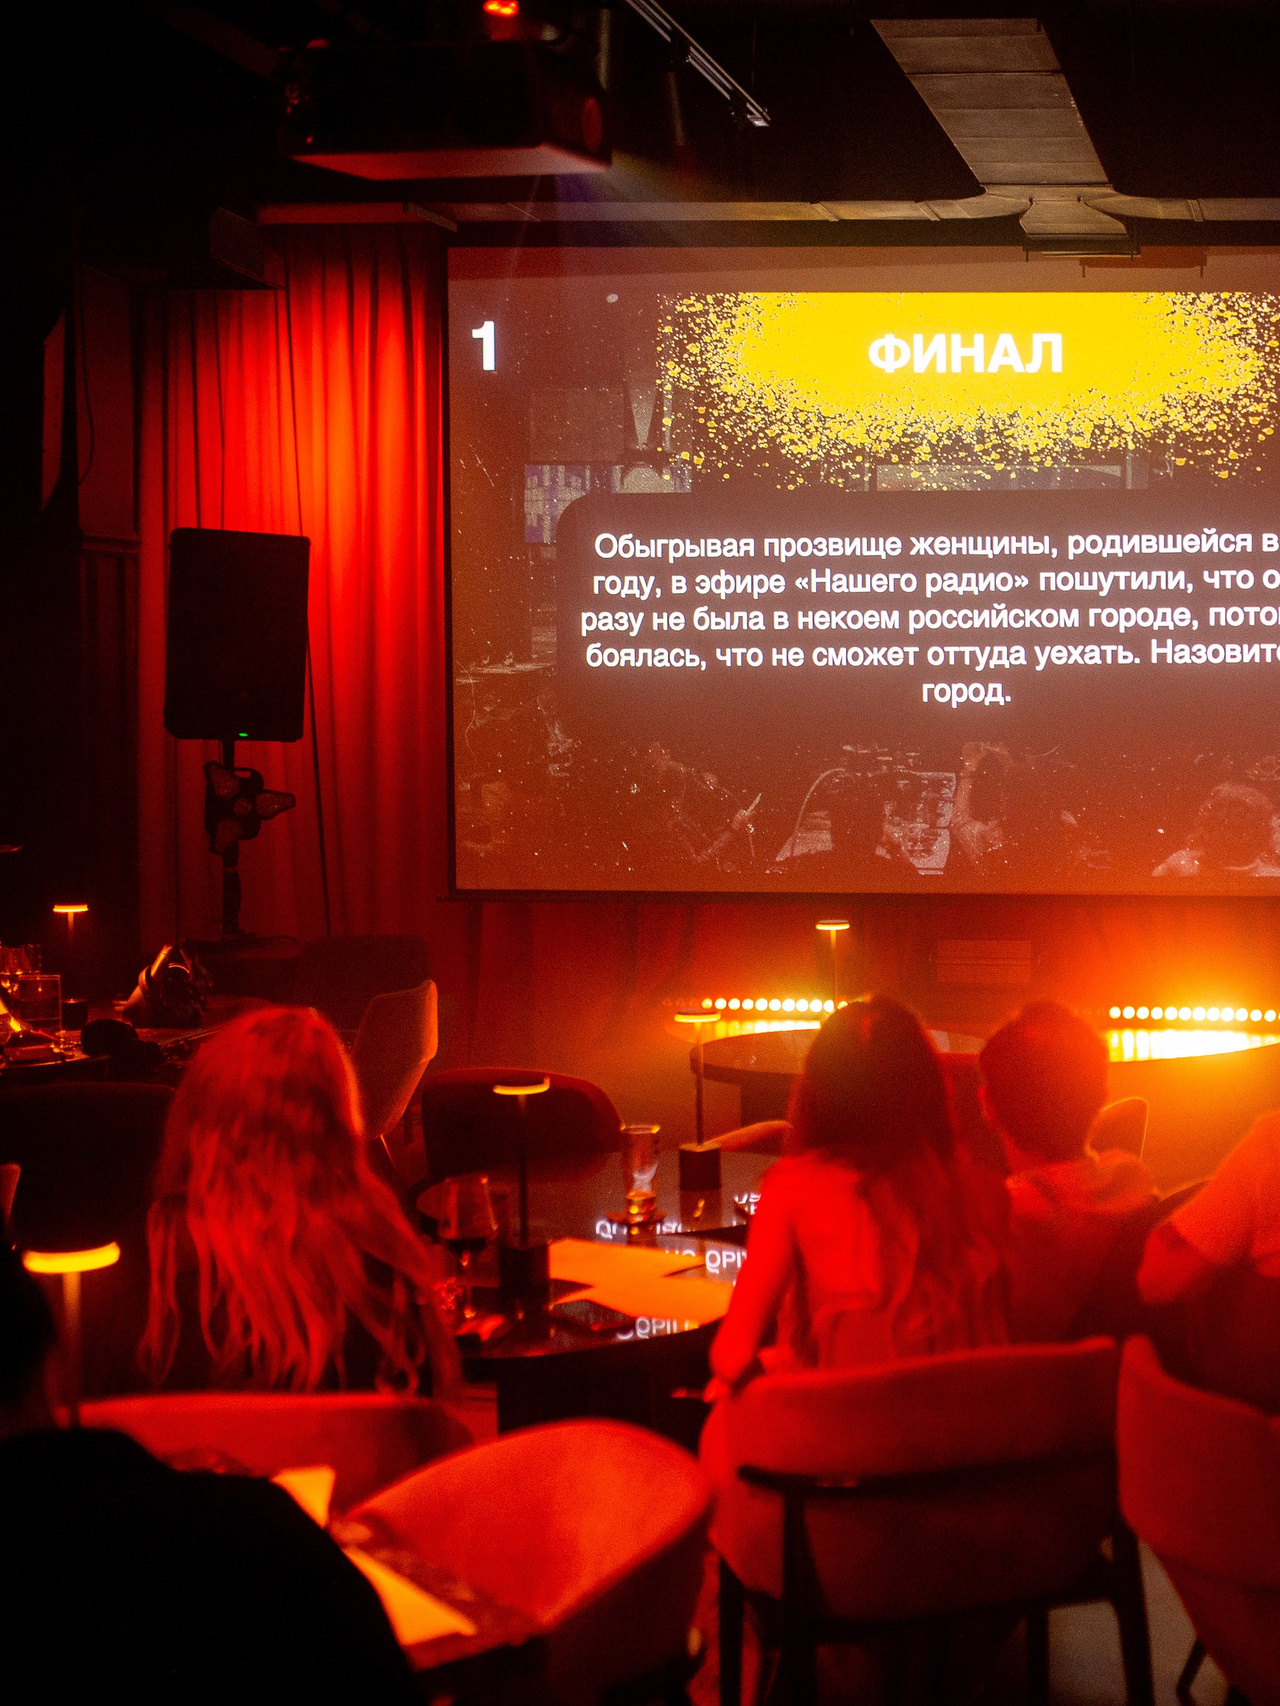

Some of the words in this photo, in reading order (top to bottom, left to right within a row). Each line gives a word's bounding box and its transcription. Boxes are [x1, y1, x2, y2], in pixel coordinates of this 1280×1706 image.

[472, 320, 495, 371] 1
[868, 333, 1063, 374] ФИНАЛ
[594, 532, 755, 564] Обыгрывая
[764, 536, 902, 563] прозвище
[909, 535, 1058, 559] женщины,
[1068, 527, 1253, 560] родившейся
[1262, 533, 1280, 552] в
[593, 575, 662, 601] году,
[671, 575, 688, 594] в
[695, 568, 786, 600] эфире
[795, 568, 918, 593] «Нашего
[925, 571, 1029, 598] радио»
[1039, 570, 1194, 597] пошутили,
[1203, 569, 1255, 590] что
[581, 611, 645, 637] разу
[652, 611, 686, 631] не
[693, 605, 766, 631] была
[773, 610, 790, 630] в
[797, 609, 900, 630] некоем
[908, 602, 1080, 635] российском
[1088, 606, 1199, 634] городе,
[586, 642, 707, 671] боялась,
[716, 647, 764, 667] что
[772, 647, 805, 667] не
[812, 646, 920, 667] сможет
[927, 645, 1027, 672] оттуда
[1033, 644, 1141, 671] уехать.
[922, 682, 1012, 709] город.
